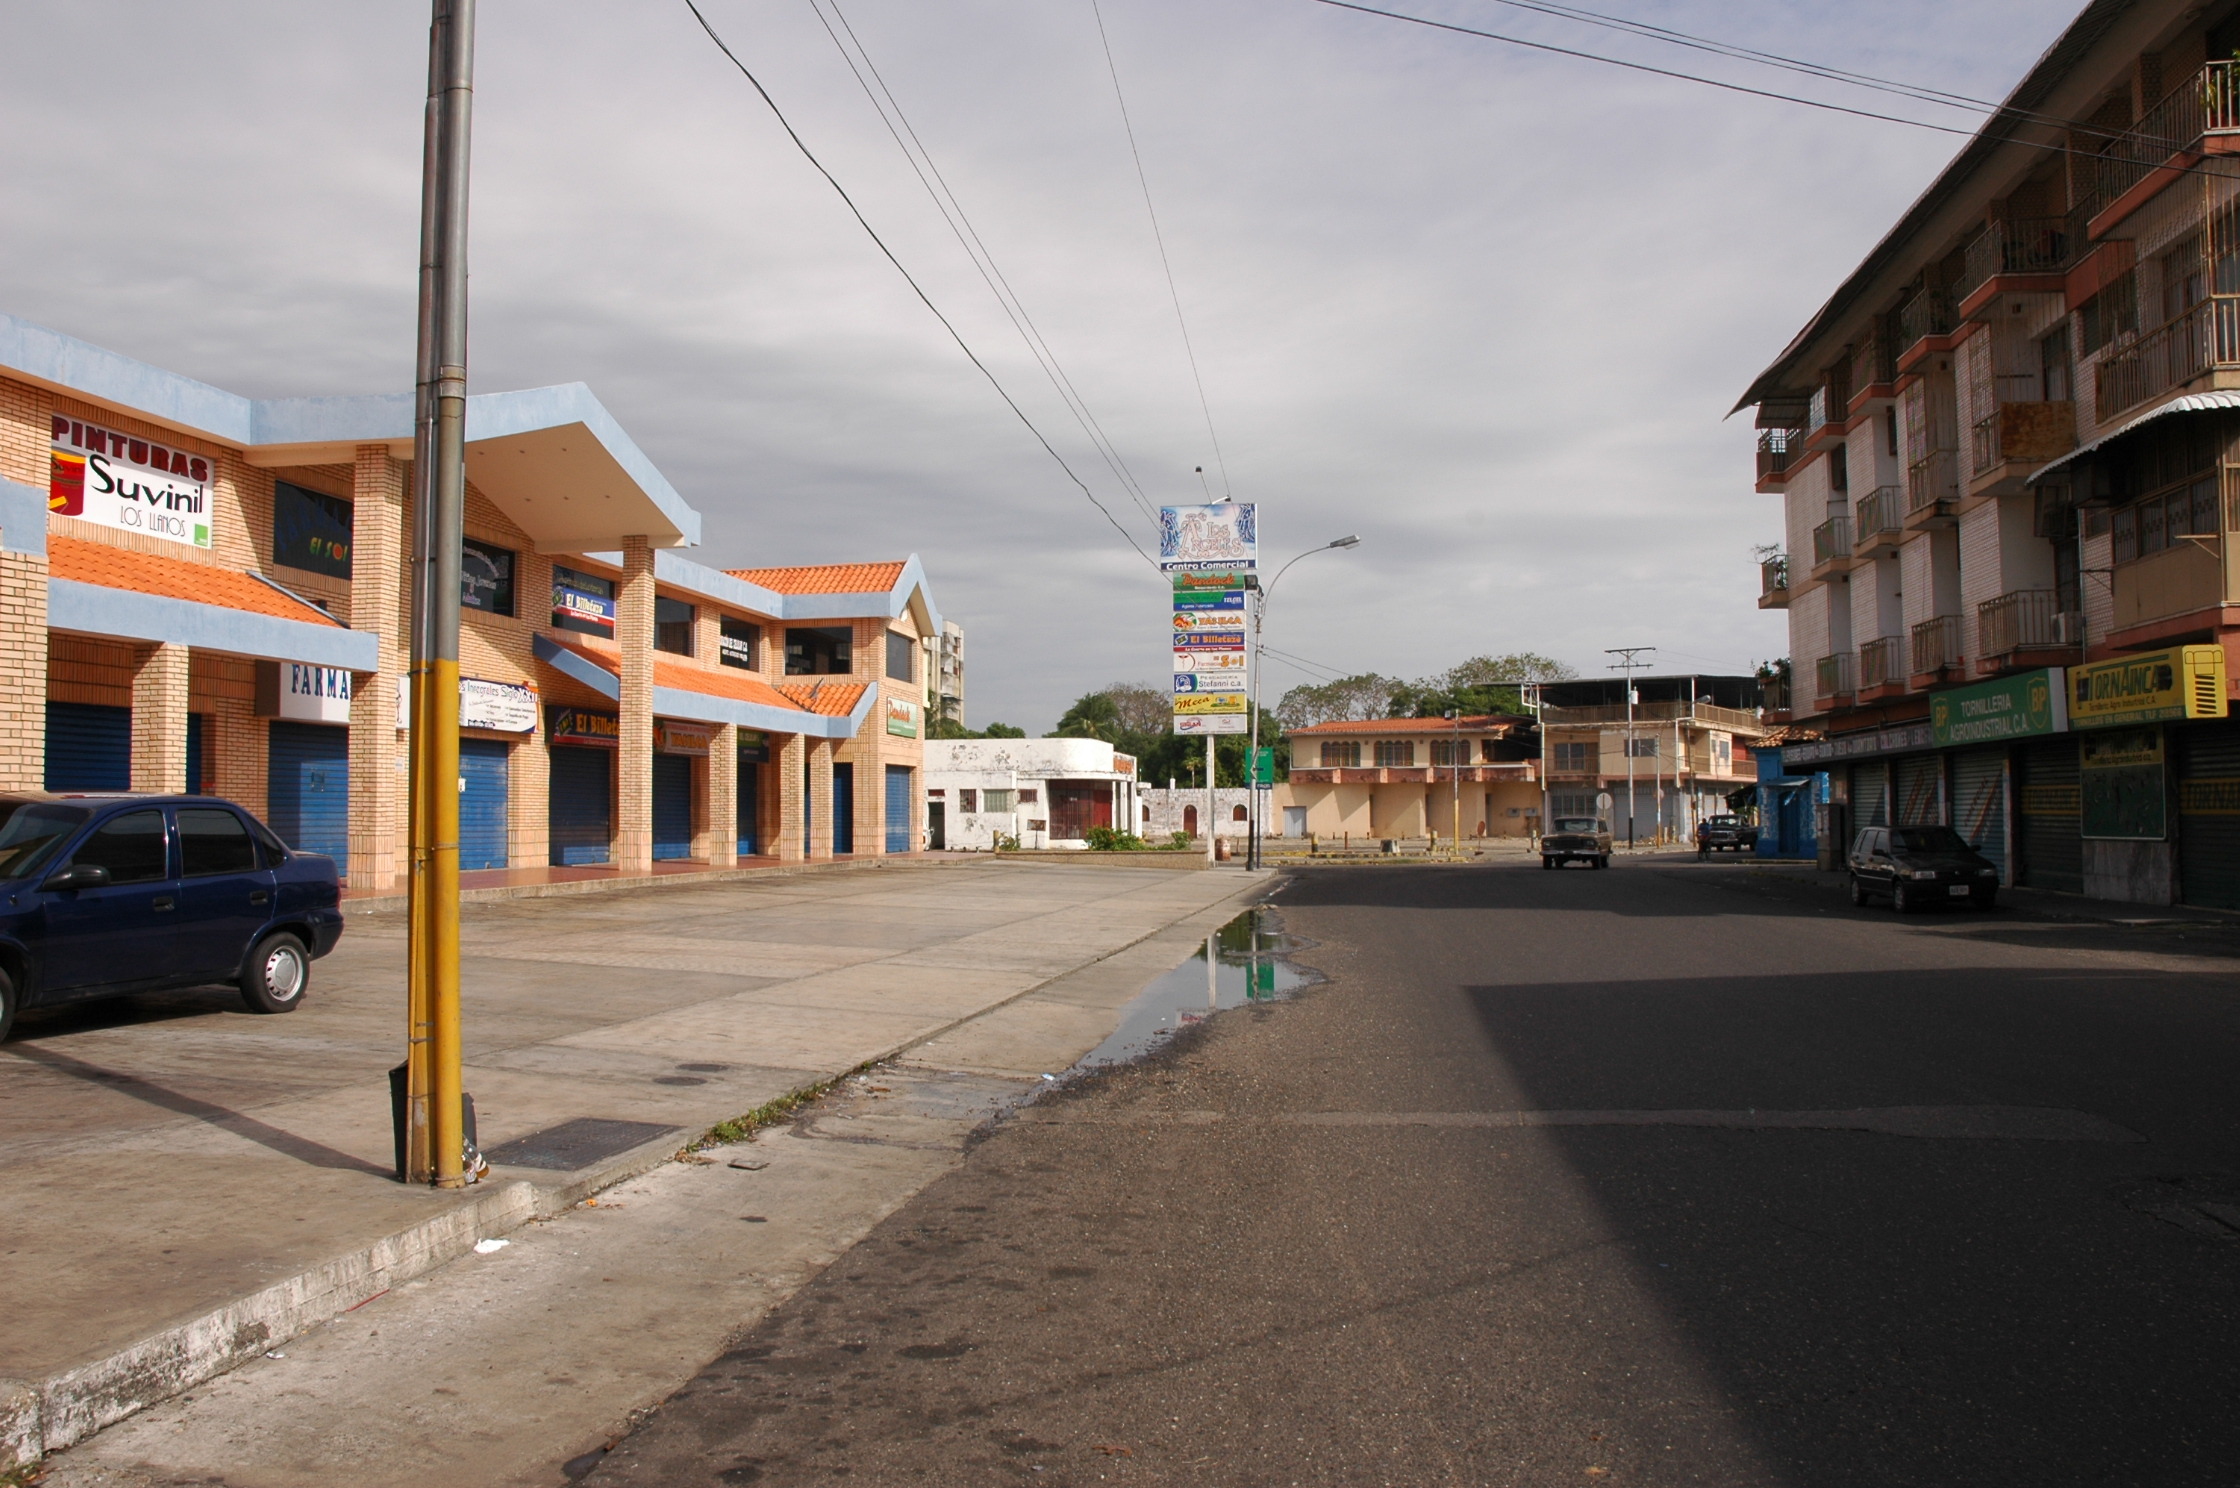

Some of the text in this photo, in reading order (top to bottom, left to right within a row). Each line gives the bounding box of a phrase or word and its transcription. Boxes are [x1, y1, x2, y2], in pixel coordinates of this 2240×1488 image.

[52, 416, 208, 482] PINTURAS
[89, 454, 204, 514] Suvinil
[120, 505, 186, 538] LOS LLANOS
[1166, 560, 1249, 571] Centro Comercial
[565, 593, 575, 607] El
[1190, 635, 1200, 644] El
[291, 663, 349, 700] FARMA
[1175, 696, 1211, 710] Meca
[1961, 693, 2012, 718] TORNILLERIA
[2031, 686, 2047, 712] BP
[575, 713, 587, 733] El
[1935, 705, 1949, 727] BP
[1950, 715, 2013, 742] AGROINDUSTRIAL
[2013, 713, 2030, 734] C.A.
